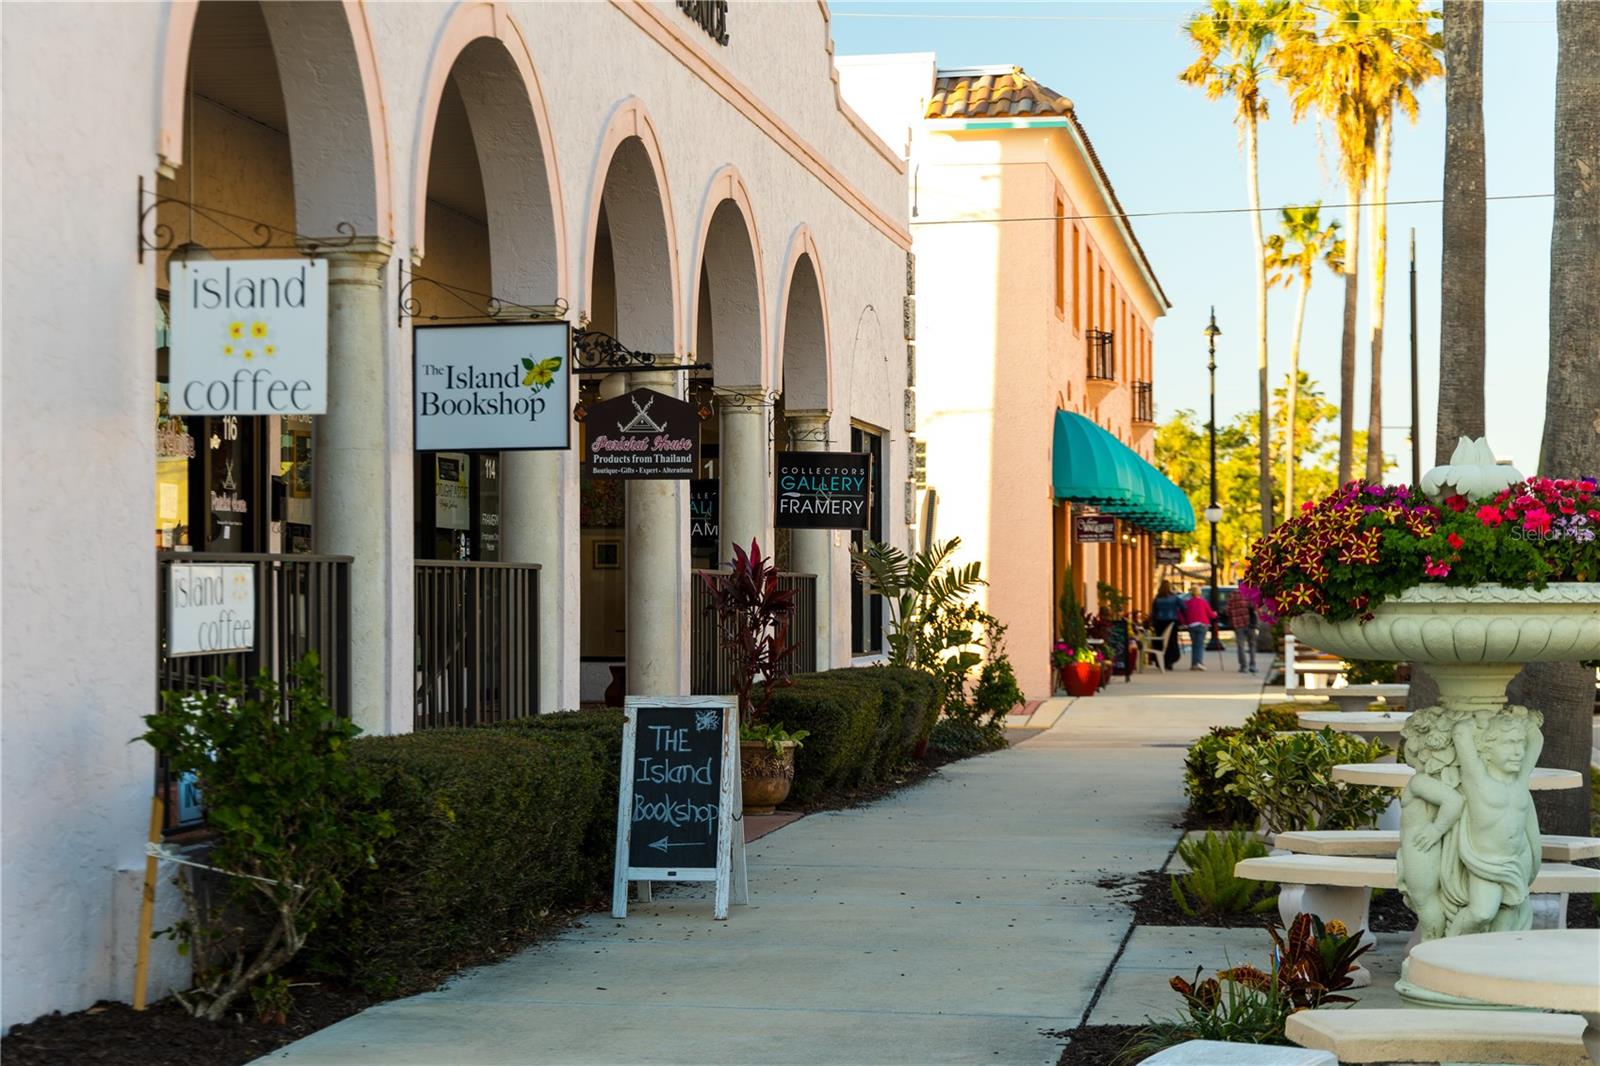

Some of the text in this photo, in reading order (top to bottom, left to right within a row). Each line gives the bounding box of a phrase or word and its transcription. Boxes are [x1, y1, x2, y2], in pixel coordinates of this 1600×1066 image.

[193, 266, 306, 309] island
[184, 368, 312, 411] coffee
[423, 364, 520, 390] The Island
[420, 391, 546, 422] Bookshop
[222, 415, 238, 441] 116
[651, 433, 693, 452] House
[485, 459, 496, 479] 114
[593, 453, 692, 464] Products from Thailand
[639, 467, 658, 475] Expert
[781, 466, 865, 476] COLLECTORS
[781, 475, 865, 491] GALLERY
[780, 498, 864, 515] FRAMERY
[175, 568, 224, 608] island
[198, 609, 252, 652] coffee
[648, 725, 692, 752] THE
[636, 757, 713, 785] Island
[631, 792, 719, 835] Bookshop
